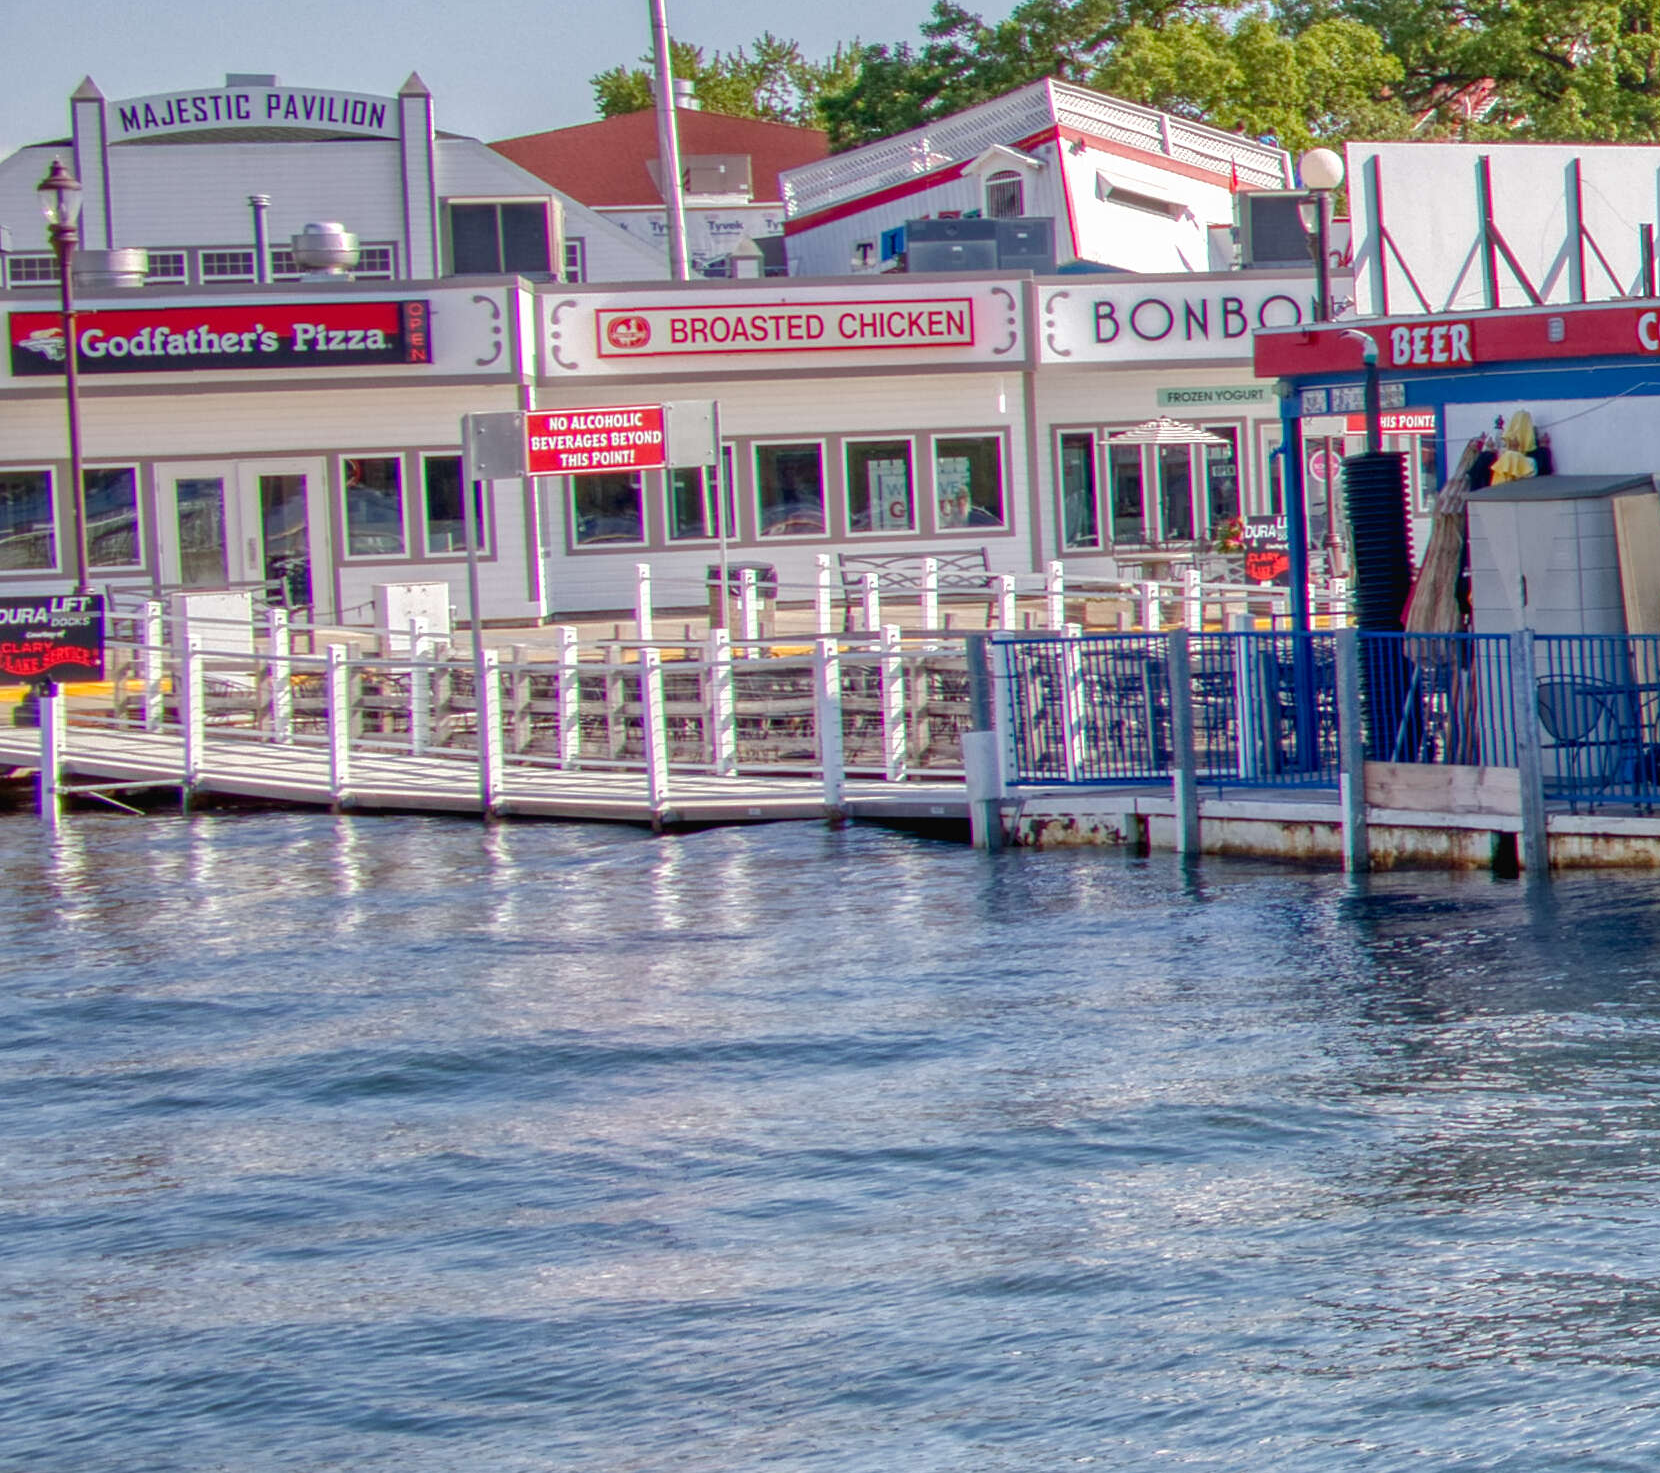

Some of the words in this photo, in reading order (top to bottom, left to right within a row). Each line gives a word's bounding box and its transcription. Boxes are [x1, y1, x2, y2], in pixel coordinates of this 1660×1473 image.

[119, 93, 251, 133] MAJESTIC
[266, 93, 387, 129] PAVILION
[409, 302, 426, 361] OPEN
[670, 314, 825, 344] BROASTED
[838, 310, 966, 339] CHICKEN
[80, 323, 280, 358] Godfather's
[1391, 324, 1473, 366] BEER
[1167, 391, 1214, 403] FROZEN
[1217, 389, 1264, 401] YOGURT
[549, 417, 568, 431] NO
[570, 413, 643, 429] ALCOHOLIC
[1380, 415, 1397, 428] HIS
[1399, 414, 1436, 428] POINT!
[531, 434, 608, 451] BEVERAGES
[610, 430, 662, 447] BEYOND
[559, 452, 589, 467] THIS
[591, 450, 635, 466] POINT!
[1245, 524, 1277, 539] DURA
[51, 597, 91, 613] LIFT
